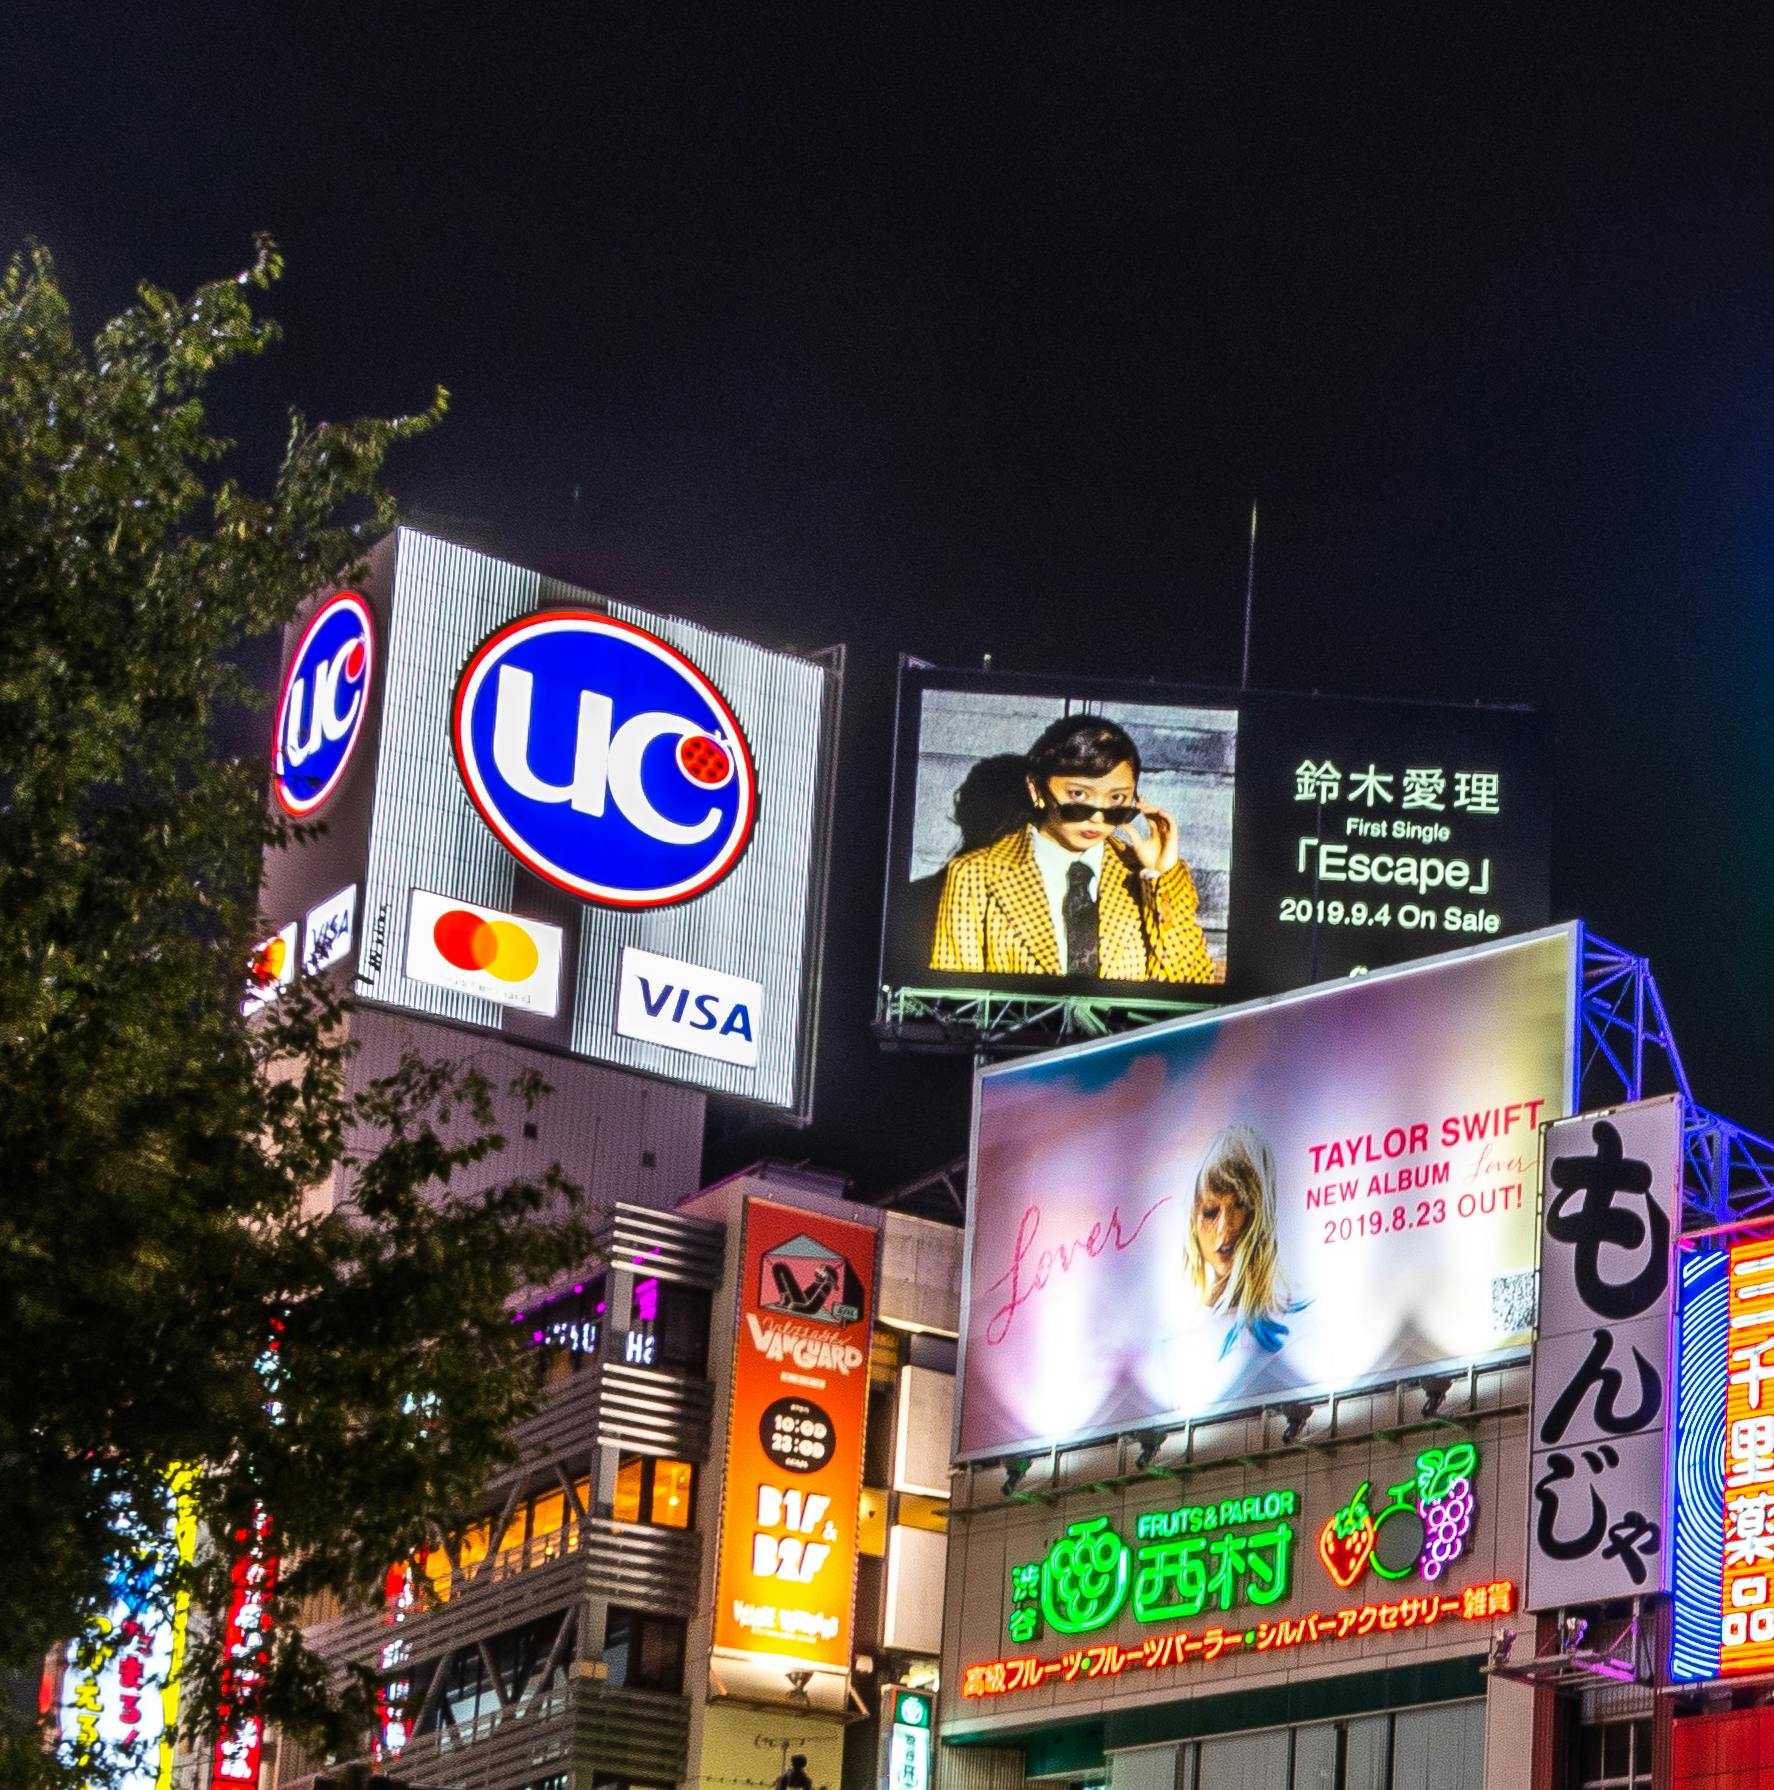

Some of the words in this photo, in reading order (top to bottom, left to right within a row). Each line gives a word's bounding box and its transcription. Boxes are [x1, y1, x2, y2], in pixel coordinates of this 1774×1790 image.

[1295, 759, 1500, 815] 鈴木愛理
[1346, 818, 1387, 839] First
[1392, 820, 1451, 845] Single
[1279, 897, 1392, 928] 2019.9.4
[1397, 904, 1436, 930] On
[1443, 905, 1500, 934] Sale
[634, 978, 755, 1042] VISA
[1308, 1122, 1429, 1175] TAYLOR
[1440, 1098, 1545, 1148] SWIFT
[1306, 1179, 1360, 1211] NEW
[1366, 1160, 1451, 1198] ALBUM
[1323, 1198, 1447, 1245] 2019.8.23
[1457, 1182, 1524, 1219] OUT!
[745, 1312, 862, 1376] VANGUARD
[1532, 1119, 1671, 1587] もんじゃ
[757, 1483, 831, 1535] B1F
[752, 1531, 831, 1584] B2F
[1133, 1522, 1294, 1623] 西村
[1009, 1564, 1039, 1643] 渋谷
